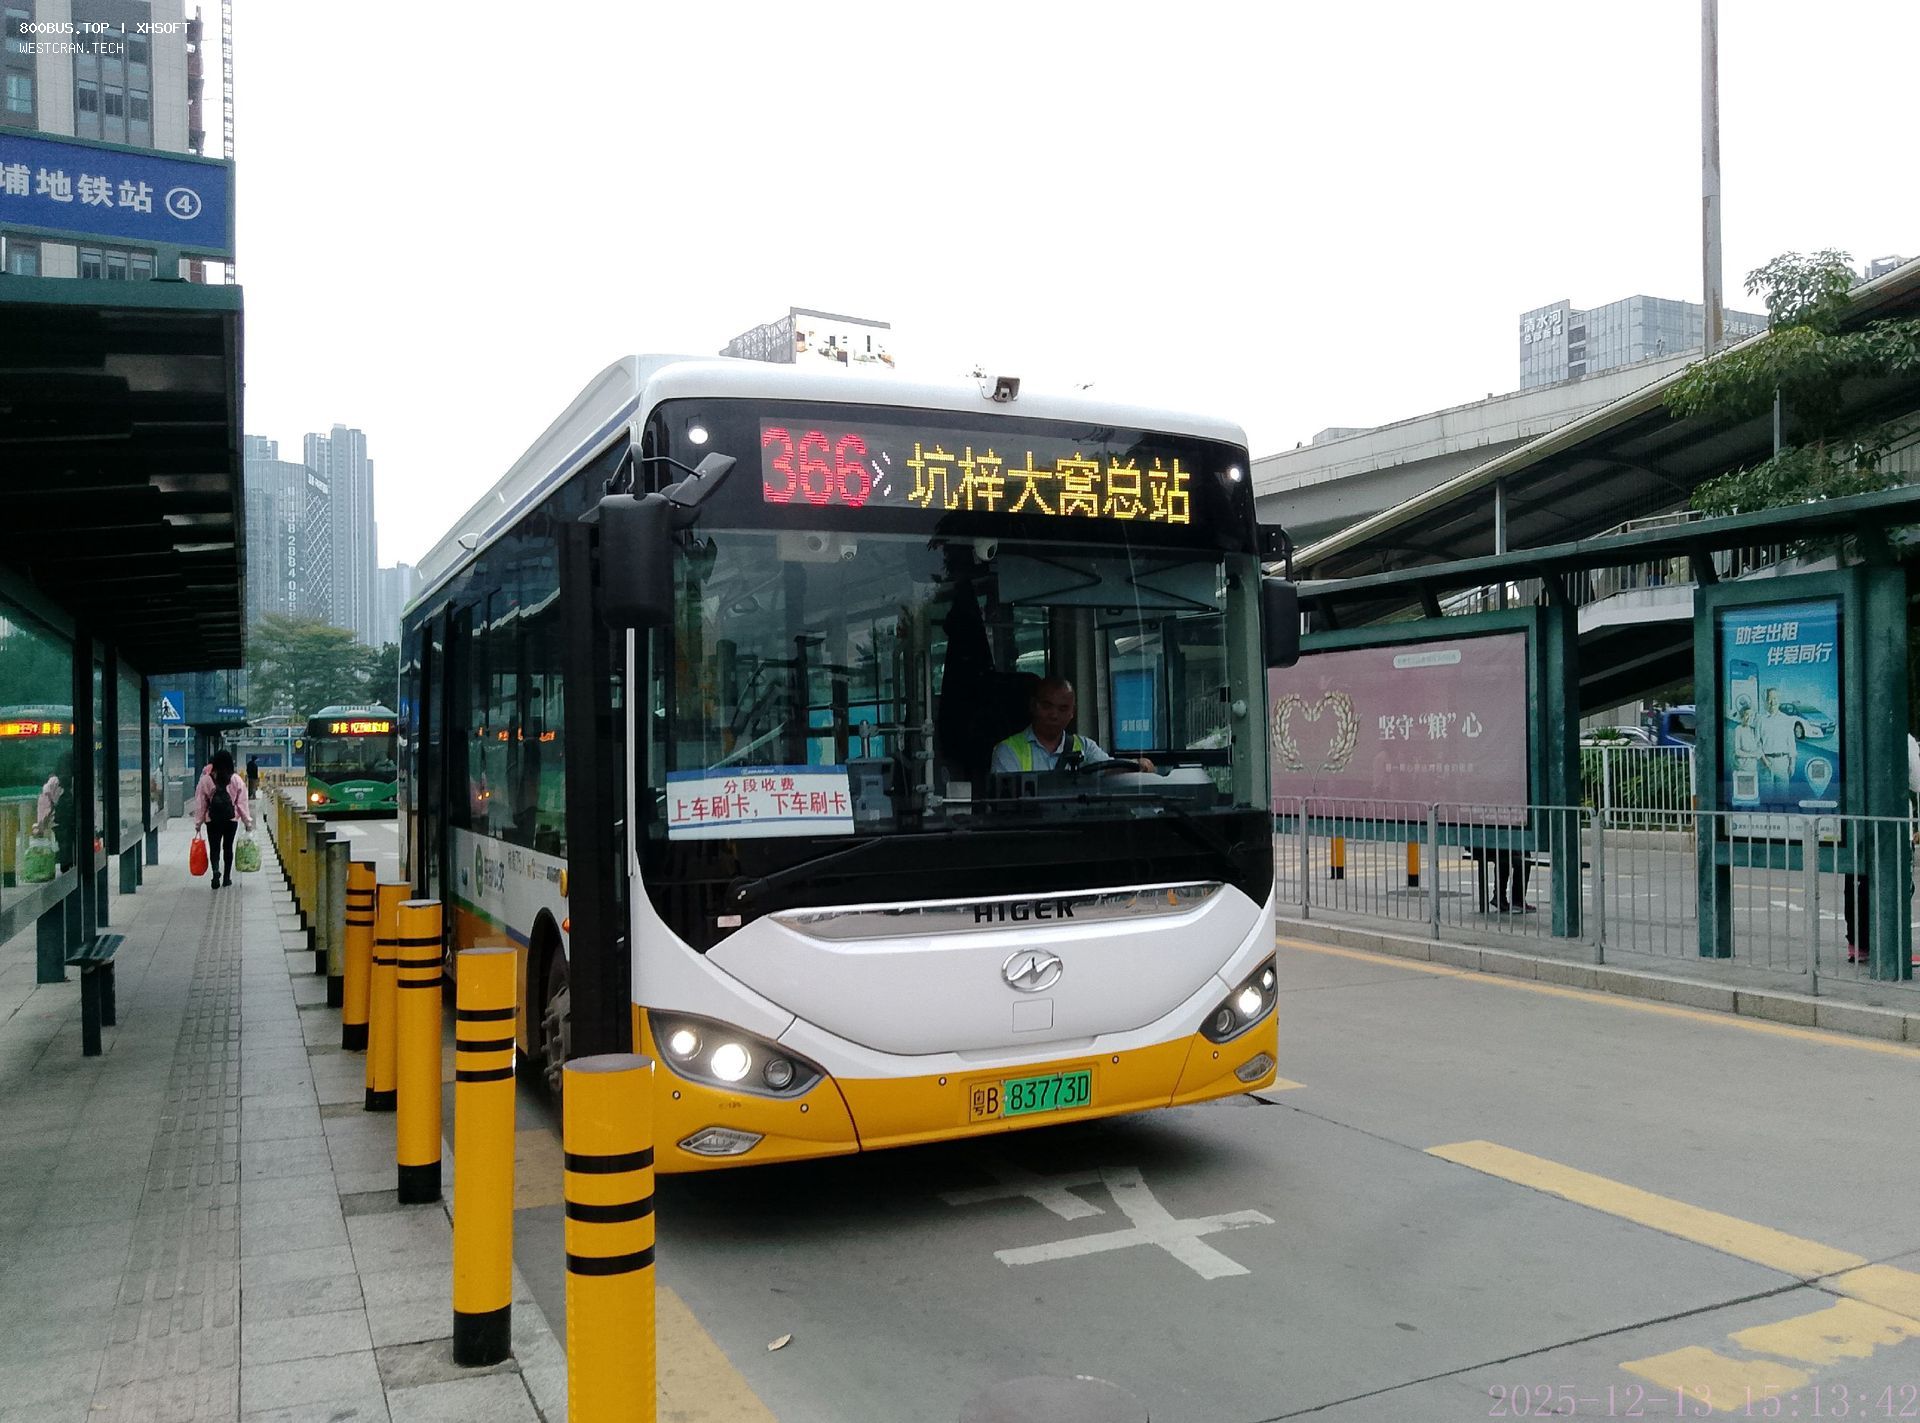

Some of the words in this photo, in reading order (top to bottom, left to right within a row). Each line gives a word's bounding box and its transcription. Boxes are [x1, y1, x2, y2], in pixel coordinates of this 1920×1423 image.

[0, 162, 154, 214] 埔地铁站
[762, 427, 871, 507] 366
[906, 442, 1191, 525] 坑梓大窝总站
[1735, 621, 1799, 645] 助老出租
[1767, 642, 1834, 666] 伴爱同行
[723, 777, 796, 794] 分段收费
[973, 899, 1076, 923] HIGER
